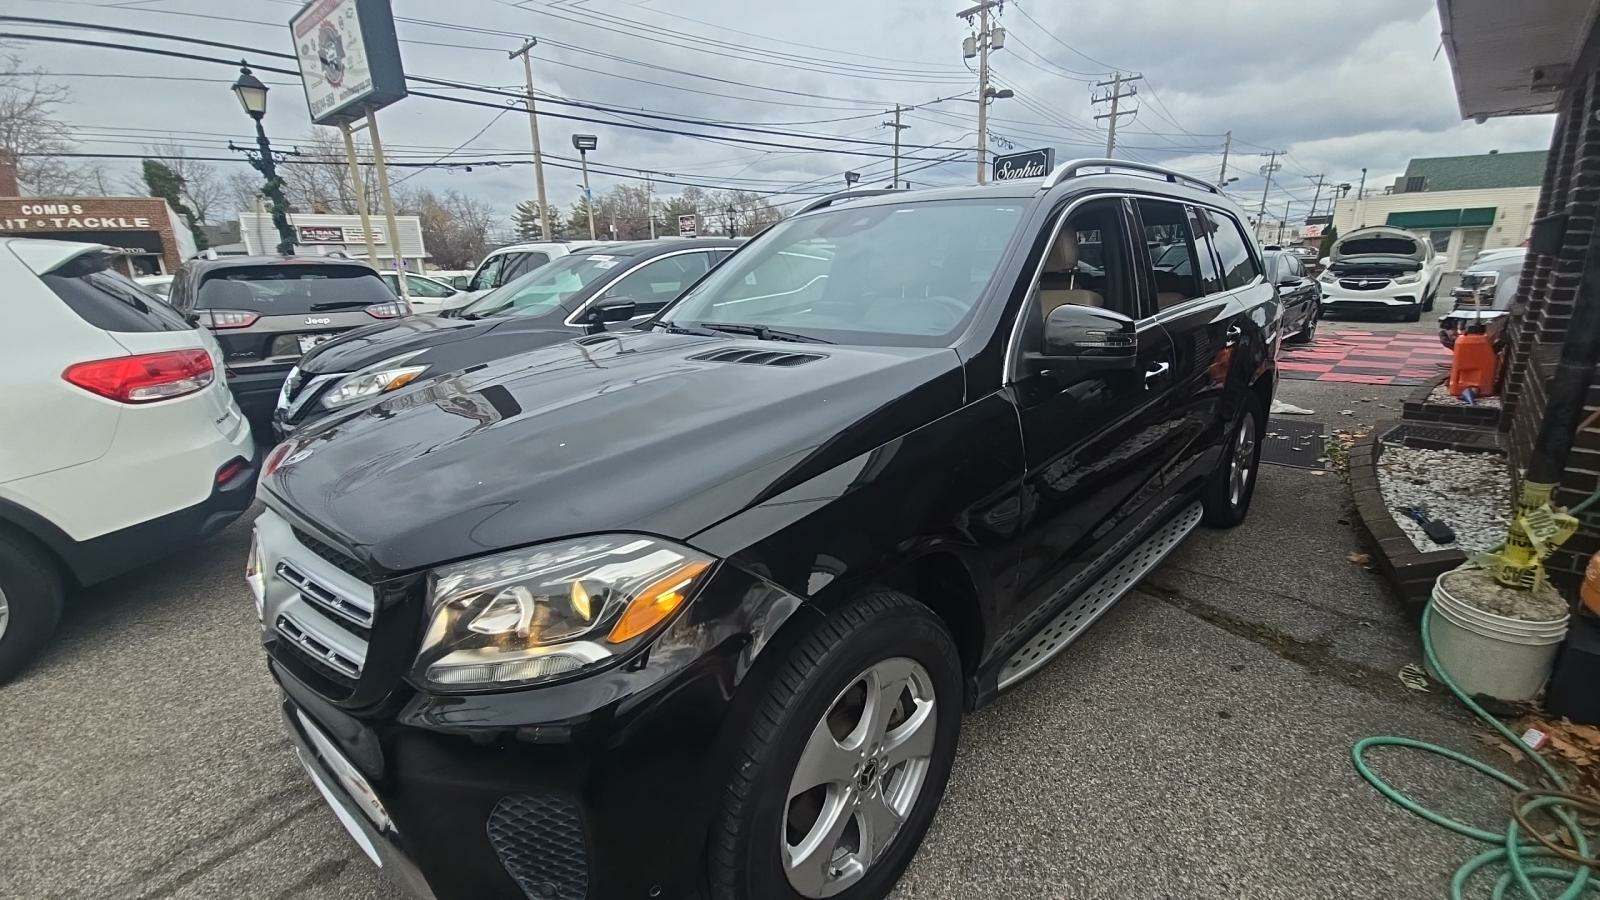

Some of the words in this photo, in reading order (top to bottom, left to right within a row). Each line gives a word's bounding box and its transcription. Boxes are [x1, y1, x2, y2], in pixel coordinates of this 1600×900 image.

[996, 161, 1044, 180] Sophia
[21, 204, 83, 215] COMBS
[50, 217, 150, 228] TACKLE
[304, 316, 330, 325] Jeep
